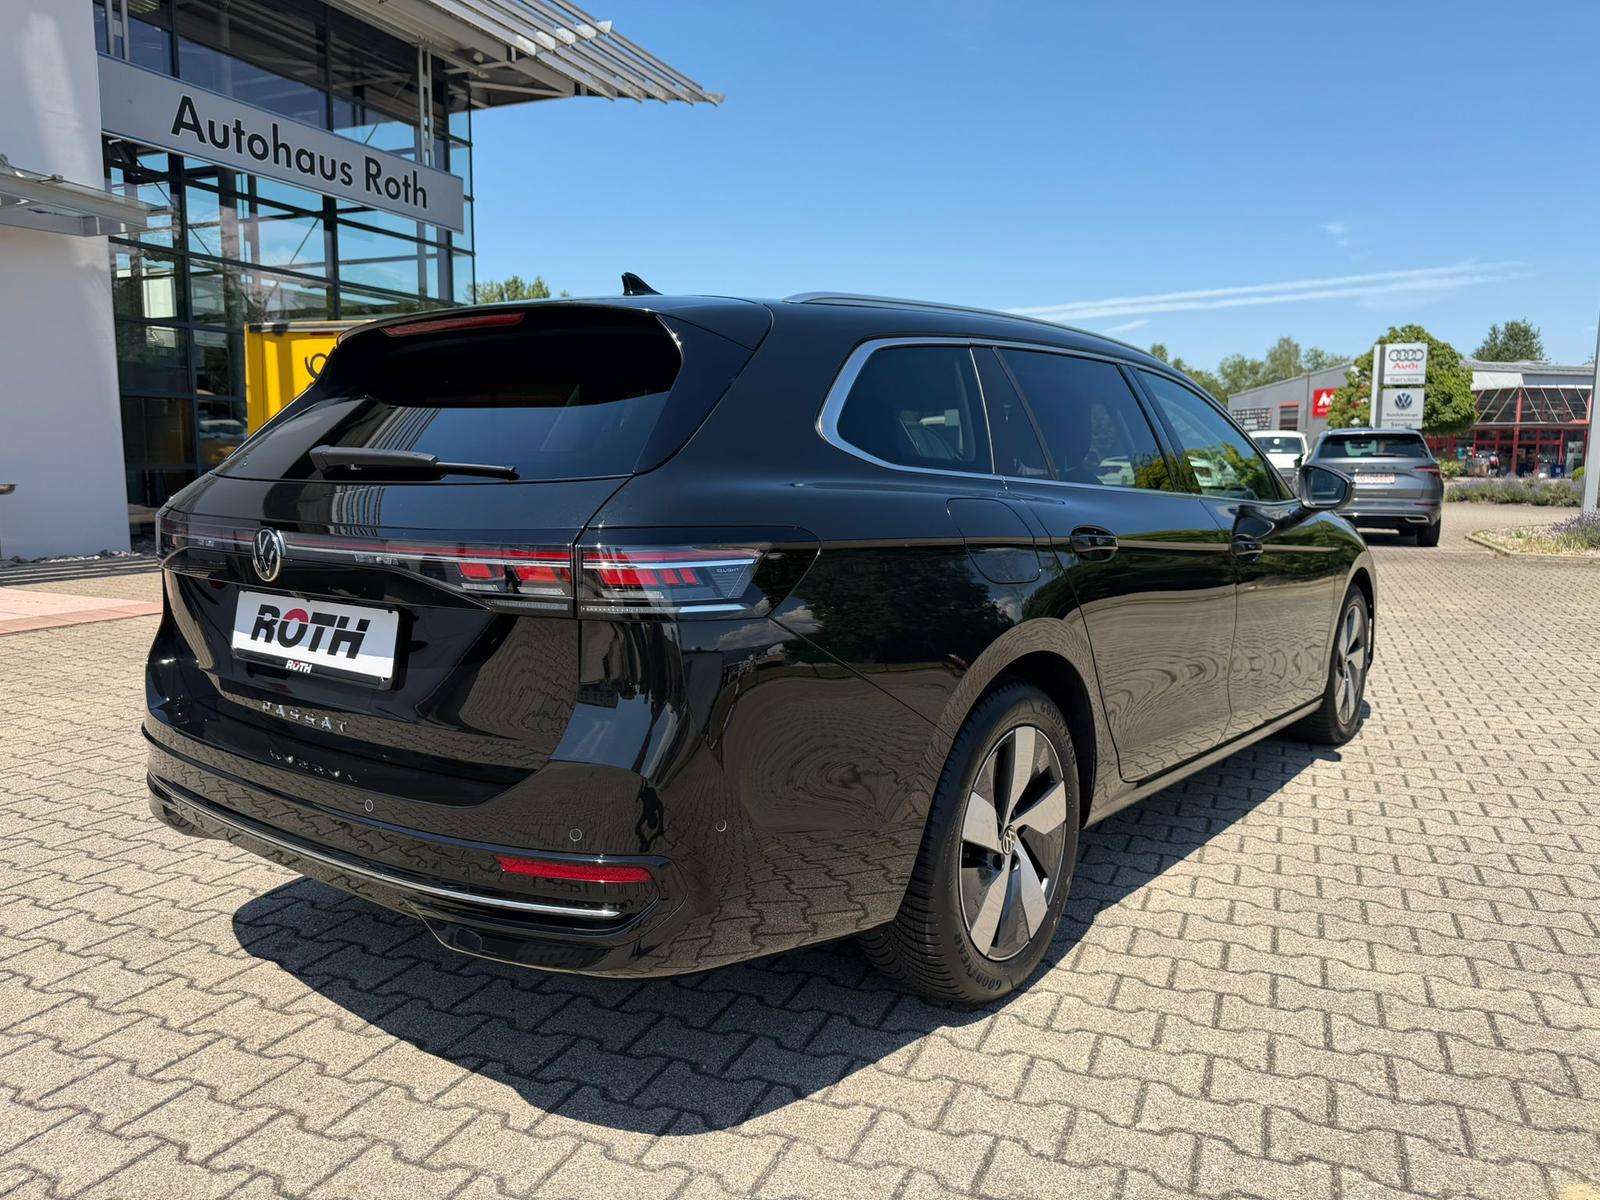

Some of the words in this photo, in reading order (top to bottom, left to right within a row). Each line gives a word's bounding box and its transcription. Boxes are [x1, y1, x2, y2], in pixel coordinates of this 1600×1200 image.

[171, 95, 353, 186] Autohaus
[365, 156, 428, 209] Roth
[1392, 362, 1419, 370] Audi
[251, 604, 371, 659] ROTH
[286, 659, 312, 674] ROTH
[262, 701, 348, 733] PASSAT
